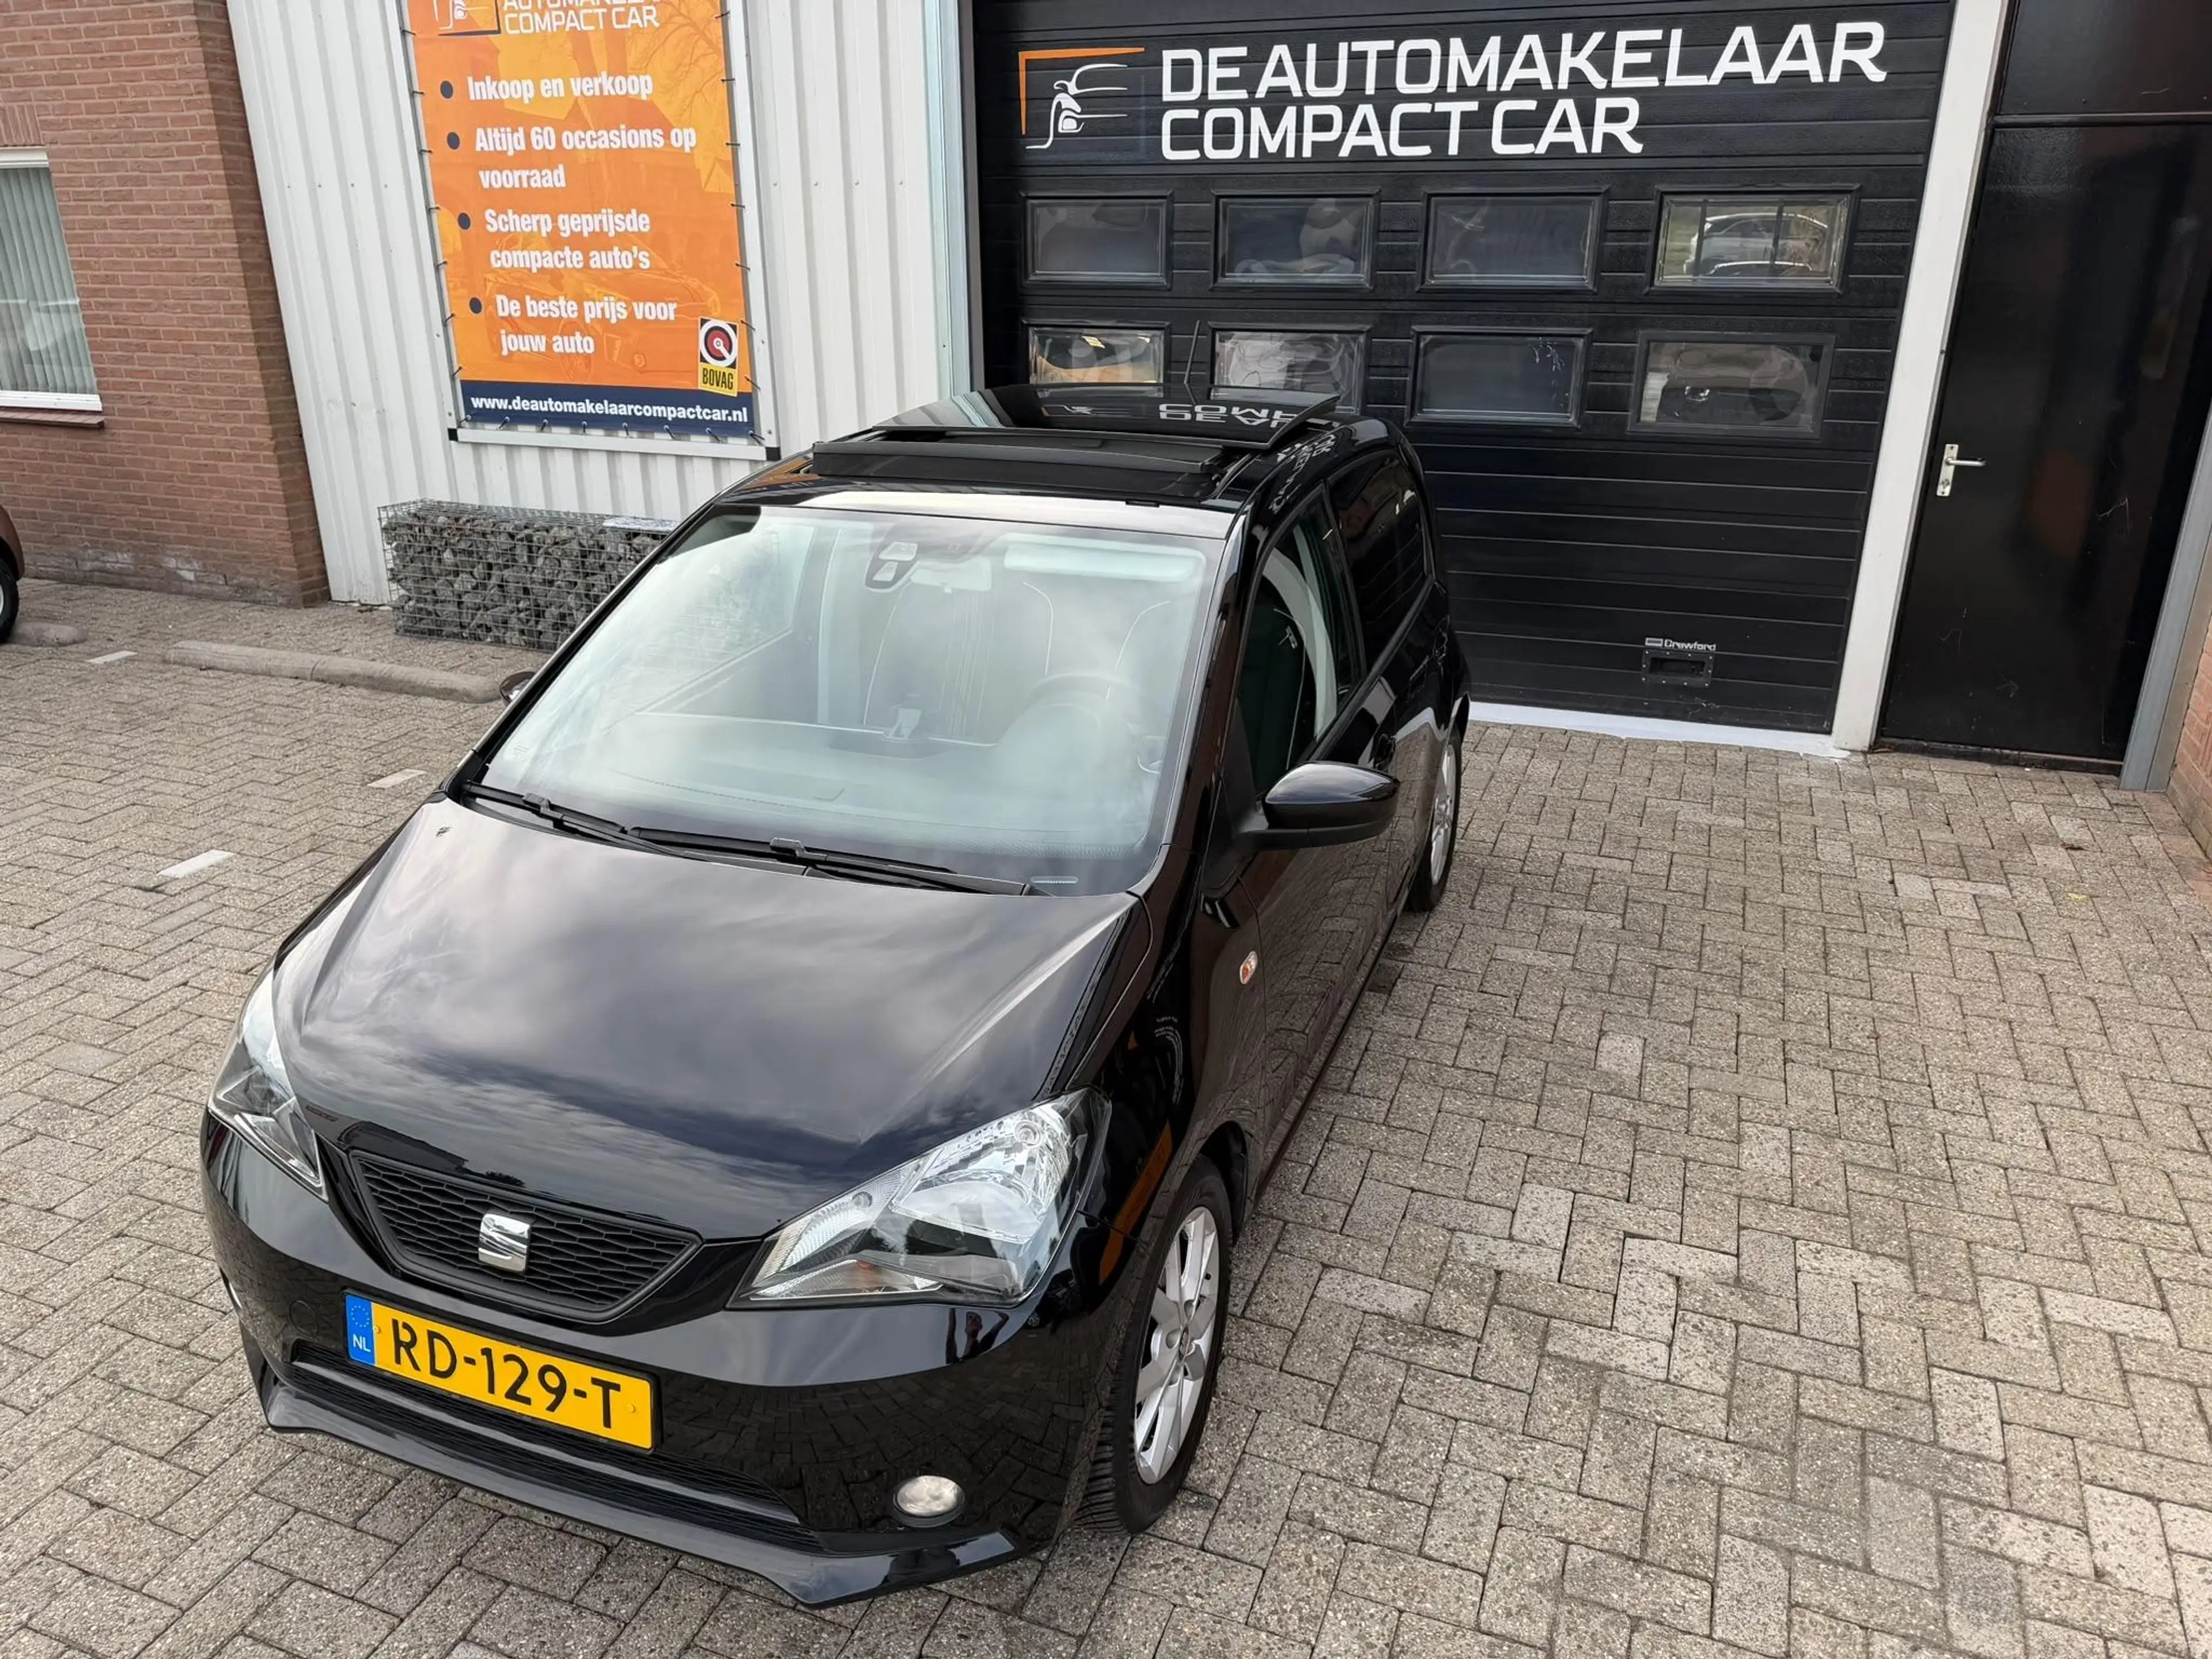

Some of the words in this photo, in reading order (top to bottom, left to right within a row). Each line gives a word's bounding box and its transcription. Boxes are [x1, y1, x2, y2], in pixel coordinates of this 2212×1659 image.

[505, 6, 607, 35] COMPACT
[611, 5, 660, 29] CAR
[467, 75, 535, 104] Inkoop
[540, 78, 565, 97] en
[570, 71, 653, 100] verkoop
[475, 127, 526, 156] Altijd
[531, 126, 556, 151] 60
[562, 124, 665, 150] occasions
[670, 127, 696, 153] op
[1161, 101, 1479, 160] COMPACT
[1491, 97, 1643, 156] CAR
[479, 164, 566, 189] voorraad
[484, 209, 553, 237] Scherp
[558, 209, 650, 237] geprijsde
[490, 246, 584, 273] compacte
[589, 246, 650, 270] auto's
[497, 294, 521, 317] De
[525, 295, 578, 319] beste
[584, 296, 628, 323] prijs
[632, 302, 677, 321] voor
[501, 330, 546, 356] jouw
[552, 332, 595, 354] auto
[702, 367, 734, 391] BOVAG
[471, 396, 748, 423] www.deautomakelaarcompactcar.nl
[353, 1335, 370, 1353] NL
[391, 1318, 621, 1429] RD-129-T
